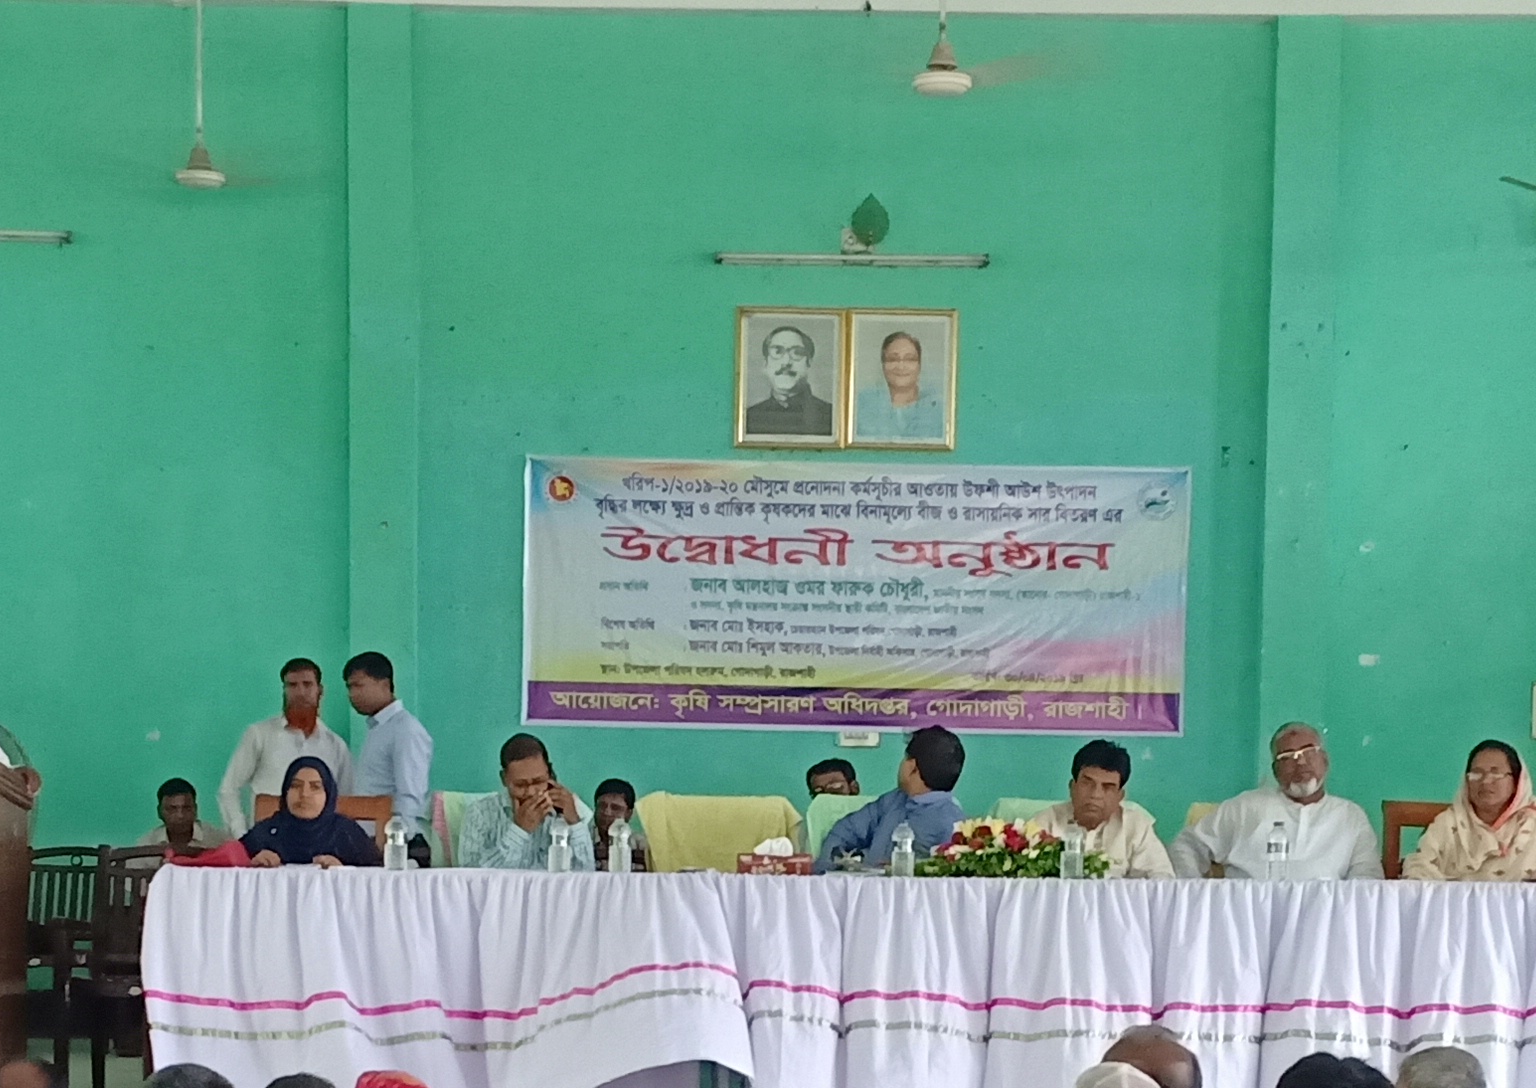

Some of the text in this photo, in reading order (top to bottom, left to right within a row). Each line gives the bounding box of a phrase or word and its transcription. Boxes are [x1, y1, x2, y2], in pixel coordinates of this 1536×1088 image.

[743, 475, 790, 498] মৌসুমে
[850, 476, 902, 501] কর্মসূচীর
[906, 481, 958, 499] আওতায়
[963, 478, 1001, 499] উফশী
[1004, 480, 1041, 500] আউশ
[594, 494, 627, 519] বৃদ্ধির
[671, 500, 695, 519] ক্ষুদ্র
[699, 501, 711, 516] ও
[715, 497, 756, 518] প্রান্তিক
[760, 501, 816, 523] কৃষকদের
[820, 502, 852, 520] মাঝে
[856, 500, 913, 524] বিনামূল্যে
[916, 501, 942, 521] বীজ
[947, 505, 959, 520] ও
[963, 502, 1024, 523] রাসায়নিক
[1027, 505, 1051, 523] সার
[1055, 502, 1098, 523] বিতরণ
[1102, 507, 1125, 524] এর
[600, 526, 1116, 577] উদ্বোধনী অনুষ্ঠান
[689, 577, 728, 595] জনাব
[794, 580, 826, 597] ওমর
[830, 580, 874, 598] ফারুক
[689, 618, 719, 633] জনাব
[689, 640, 718, 654] জনাব
[746, 637, 776, 657] শিমুল
[549, 690, 660, 711] আয়োজনে:
[668, 688, 711, 719] কৃষি
[717, 693, 816, 716] সম্প্রসারণ
[822, 693, 918, 720] অধিদপ্তর,
[925, 693, 1034, 721] গোদাগাড়ী,
[1042, 697, 1130, 720] রাজশাহী
